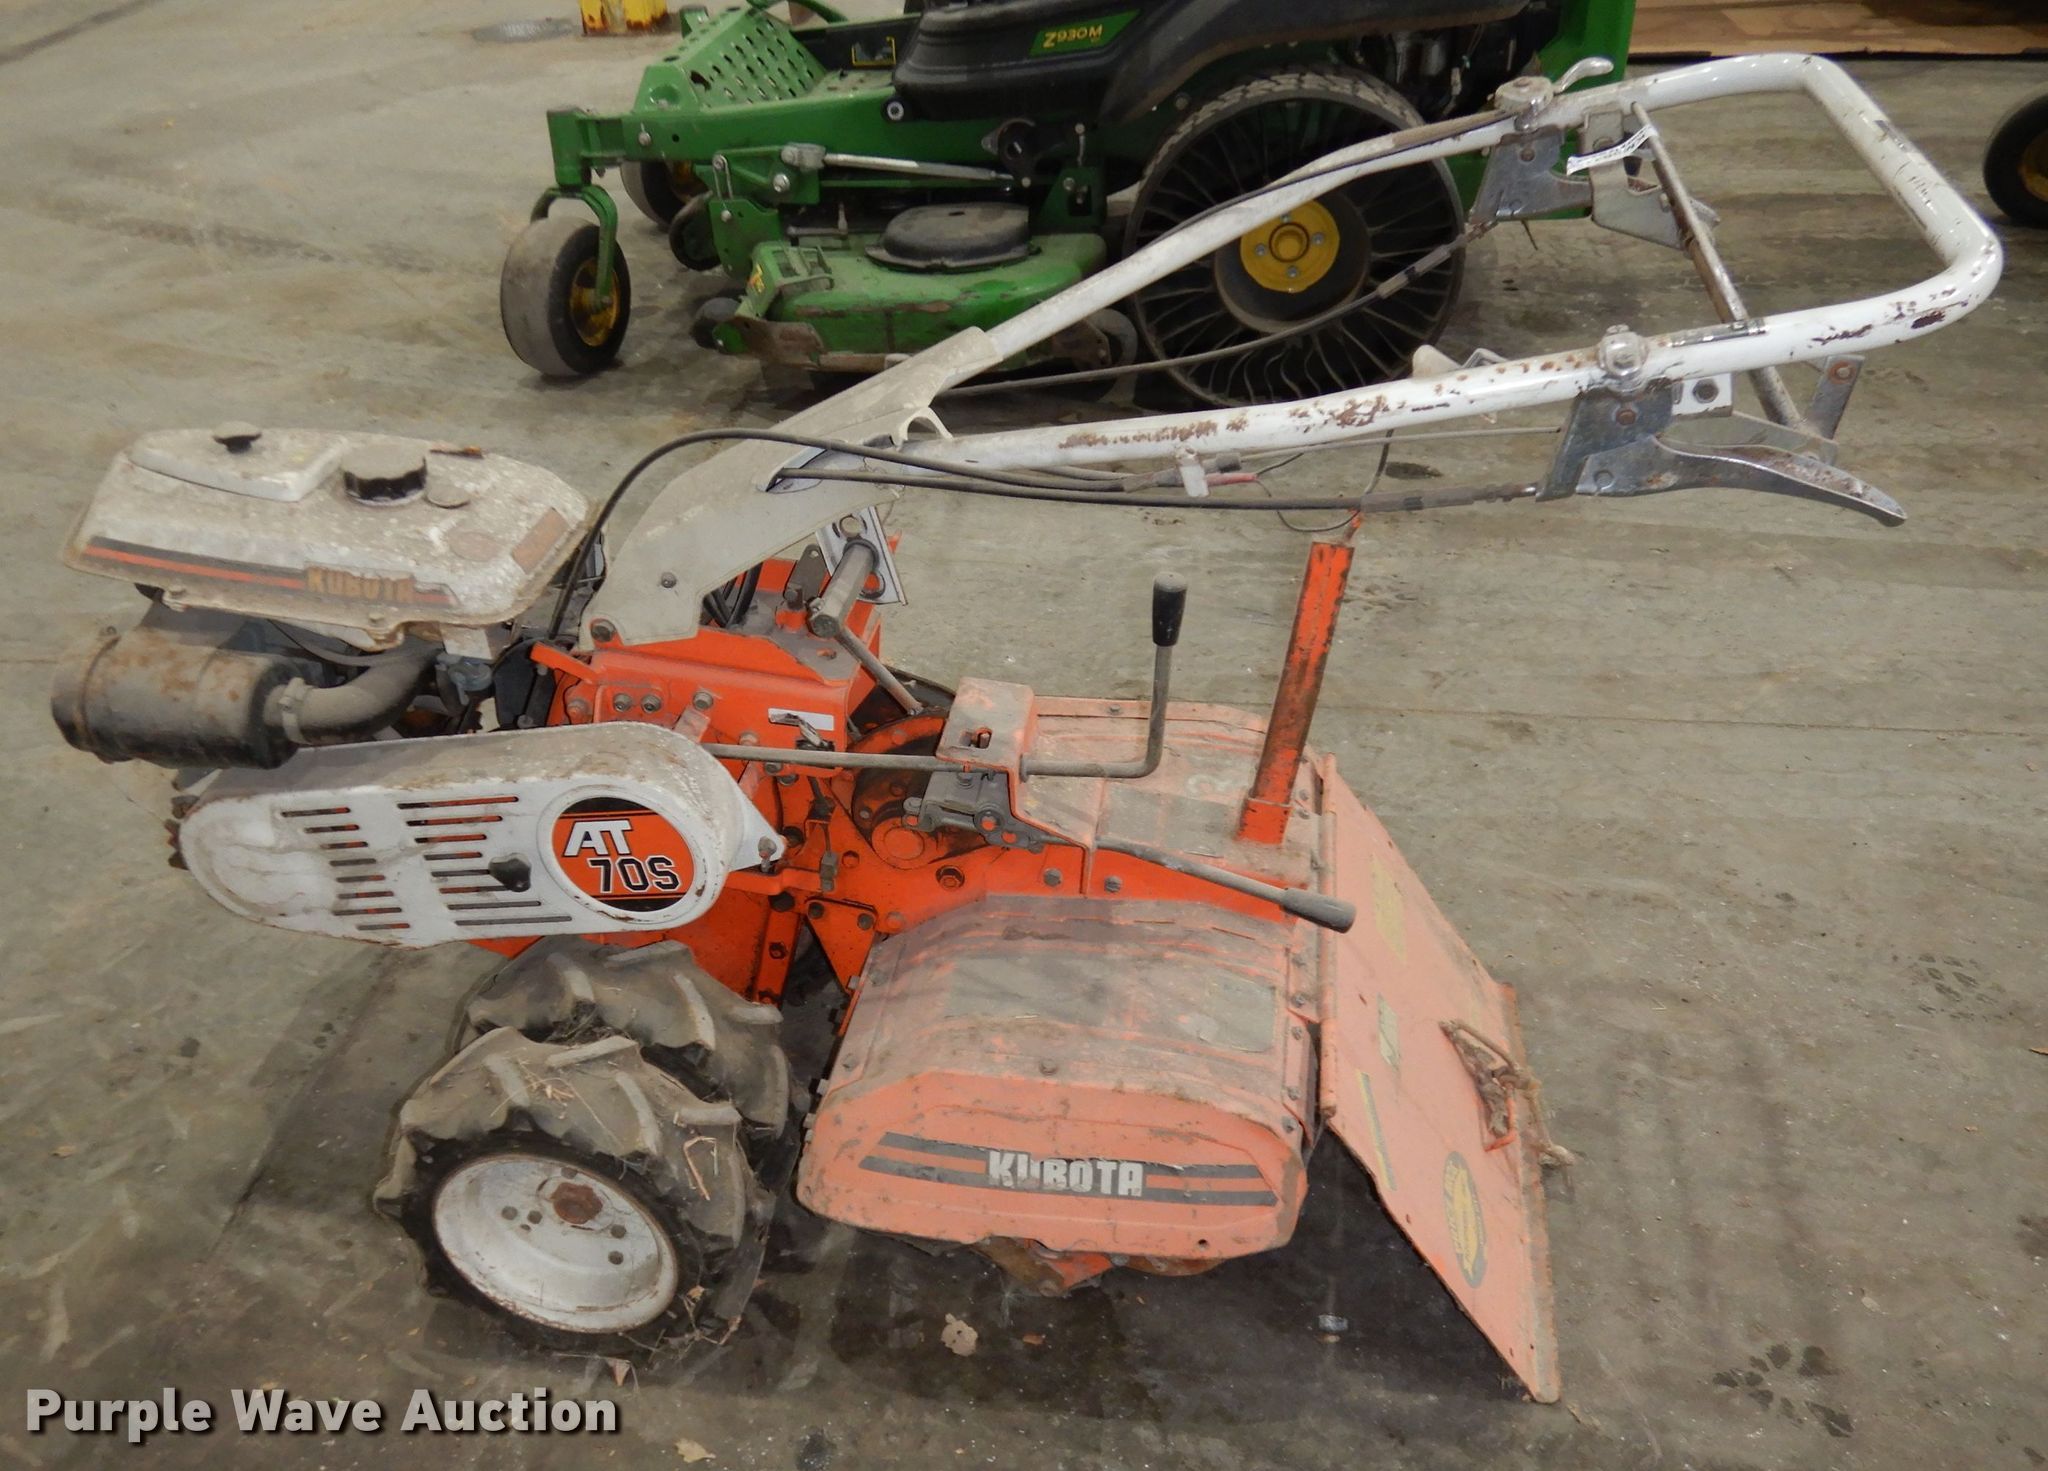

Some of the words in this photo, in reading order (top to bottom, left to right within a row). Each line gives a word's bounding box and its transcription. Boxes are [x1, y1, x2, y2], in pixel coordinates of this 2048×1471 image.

[1043, 24, 1103, 48] Z930M
[563, 819, 632, 857] AT
[587, 856, 681, 893] 70S
[988, 1150, 1143, 1196] KUBOTA
